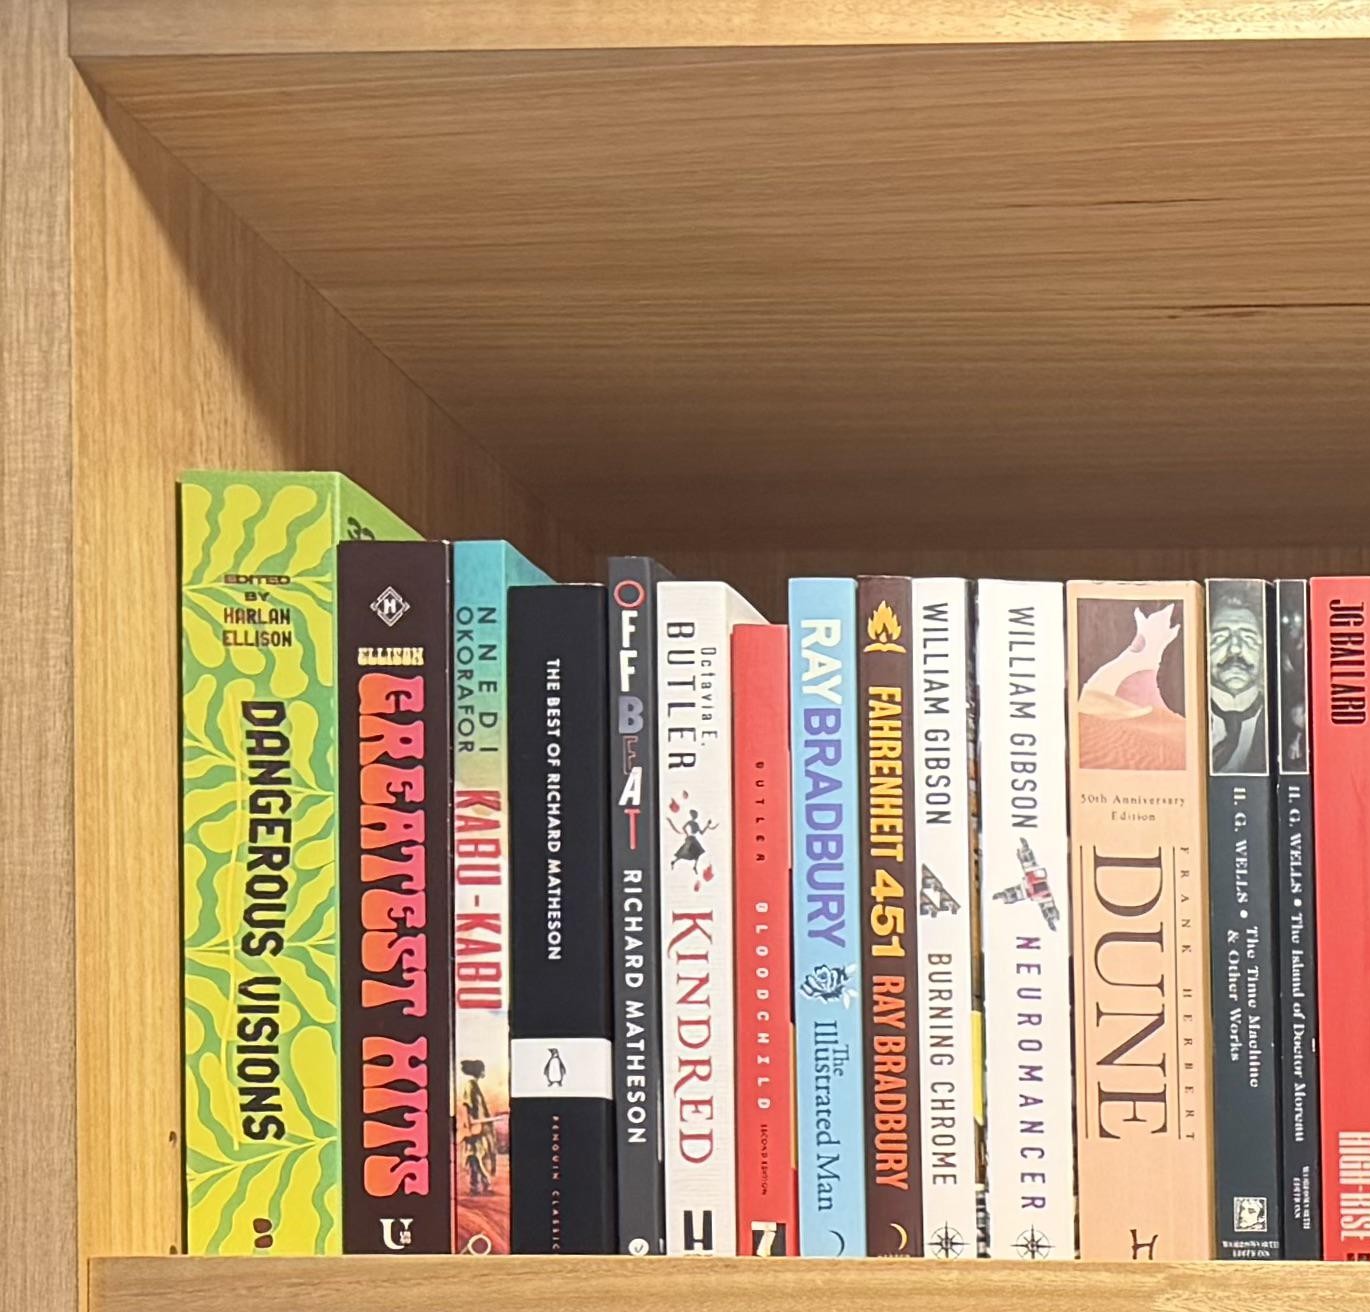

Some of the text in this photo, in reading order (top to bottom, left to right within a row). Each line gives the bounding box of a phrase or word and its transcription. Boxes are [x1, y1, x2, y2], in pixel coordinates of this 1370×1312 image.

[222, 628, 292, 647] ELLISON
[223, 575, 290, 585] EDITED
[223, 609, 291, 625] HARLAN
[244, 590, 269, 602] BY
[237, 700, 292, 1141] DANGEROUS VISIONS
[358, 670, 430, 1197] GREATEST HITS
[547, 659, 561, 960] THE BEST OF RICHARD MATHESON
[869, 686, 905, 957] FAHRENHEIT 451
[672, 911, 716, 1164] KINDRED
[928, 953, 957, 1185] BURNING CHROME
[1091, 846, 1169, 1139] DUNE
